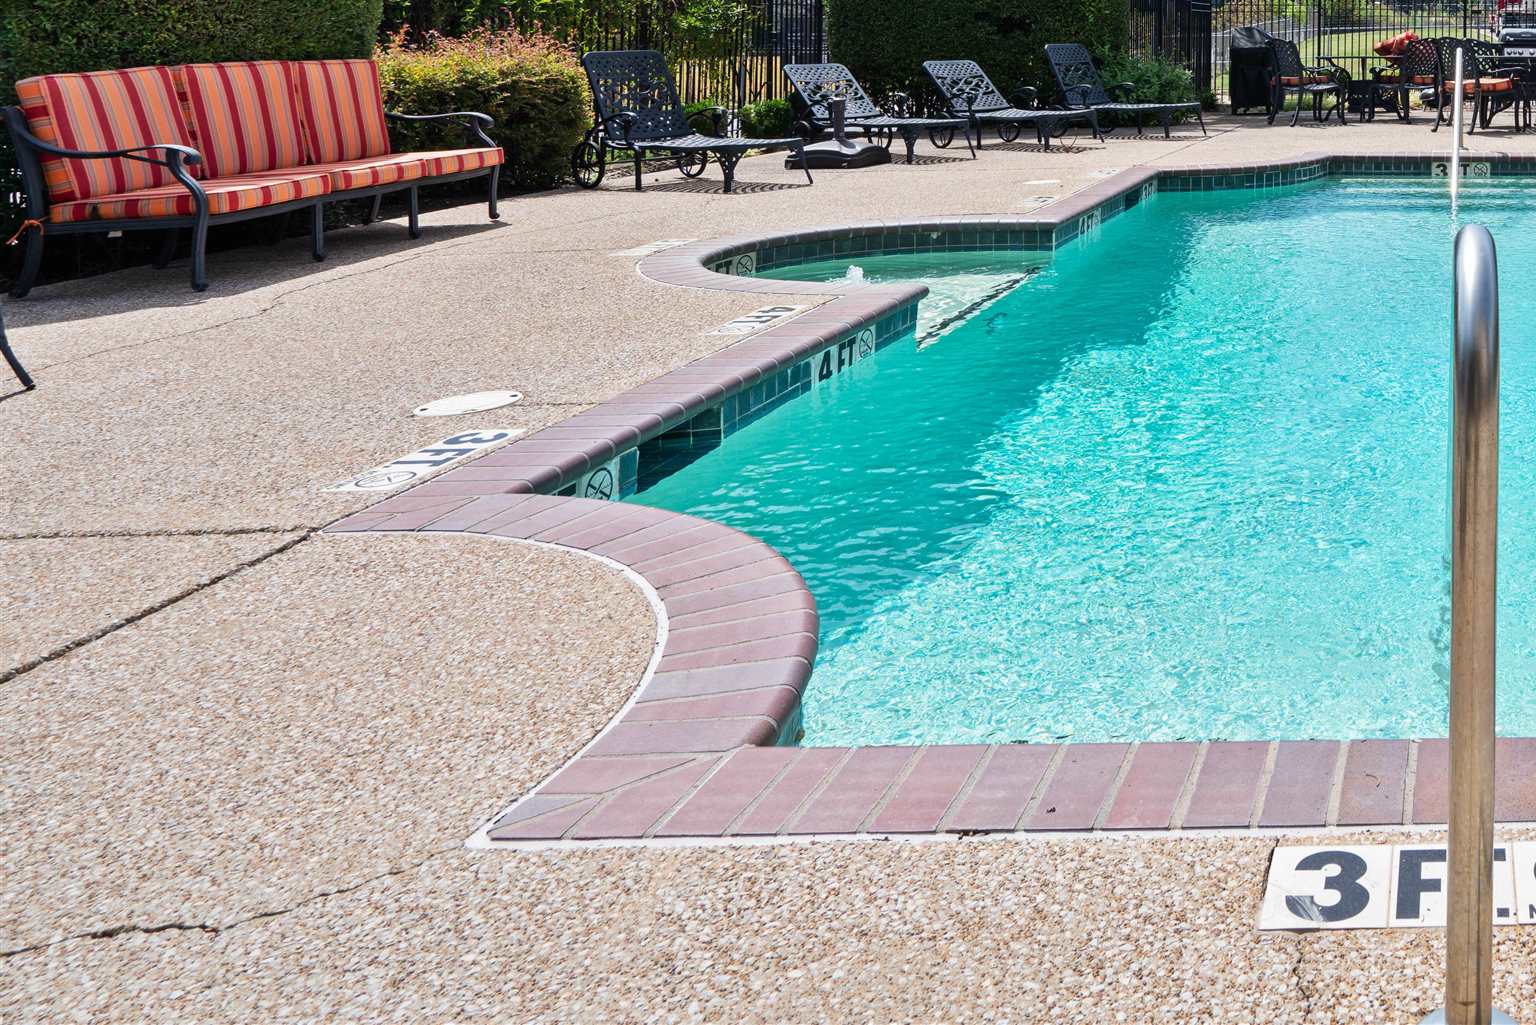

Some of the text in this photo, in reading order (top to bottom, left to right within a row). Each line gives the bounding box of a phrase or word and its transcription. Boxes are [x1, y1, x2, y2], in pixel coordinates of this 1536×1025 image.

[818, 335, 858, 382] 4 FT
[442, 432, 510, 445] 3
[1285, 850, 1371, 922] 3
